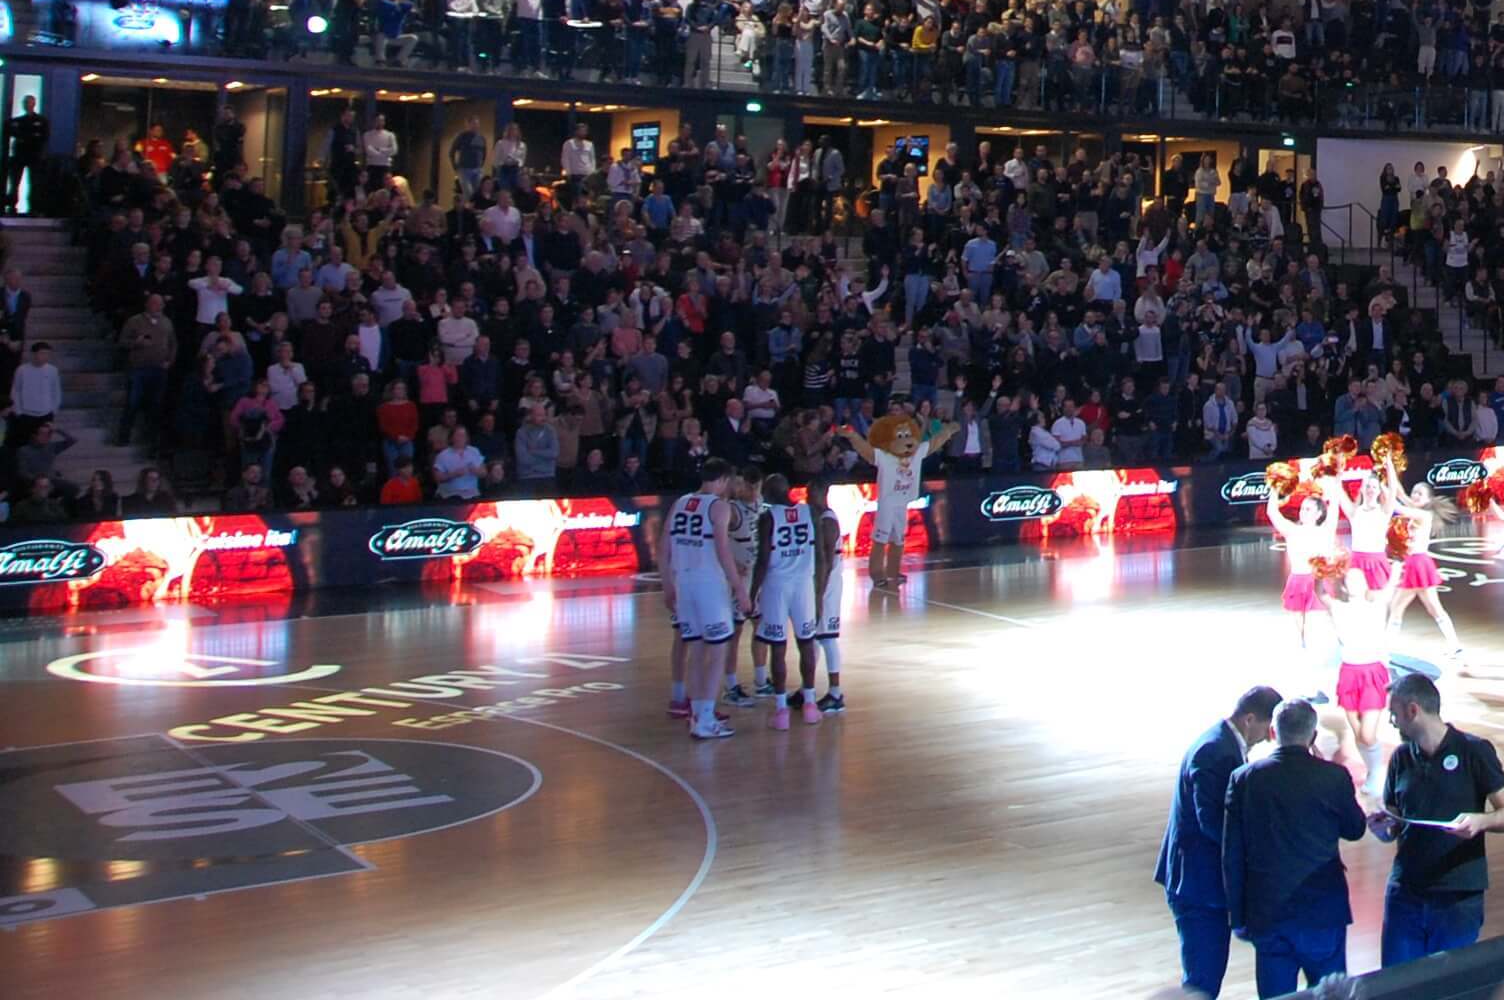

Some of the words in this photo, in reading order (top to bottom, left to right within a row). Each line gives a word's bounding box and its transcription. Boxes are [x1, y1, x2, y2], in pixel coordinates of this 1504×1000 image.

[1436, 462, 1483, 485] Amalfi
[992, 491, 1051, 514] Amalfi
[672, 512, 703, 537] 22
[776, 523, 810, 548] 35
[385, 526, 467, 554] Amalfi
[0, 548, 89, 579] Amalfi
[166, 664, 550, 742] CENTURY
[391, 696, 558, 730] Espace
[530, 681, 623, 699] Pro
